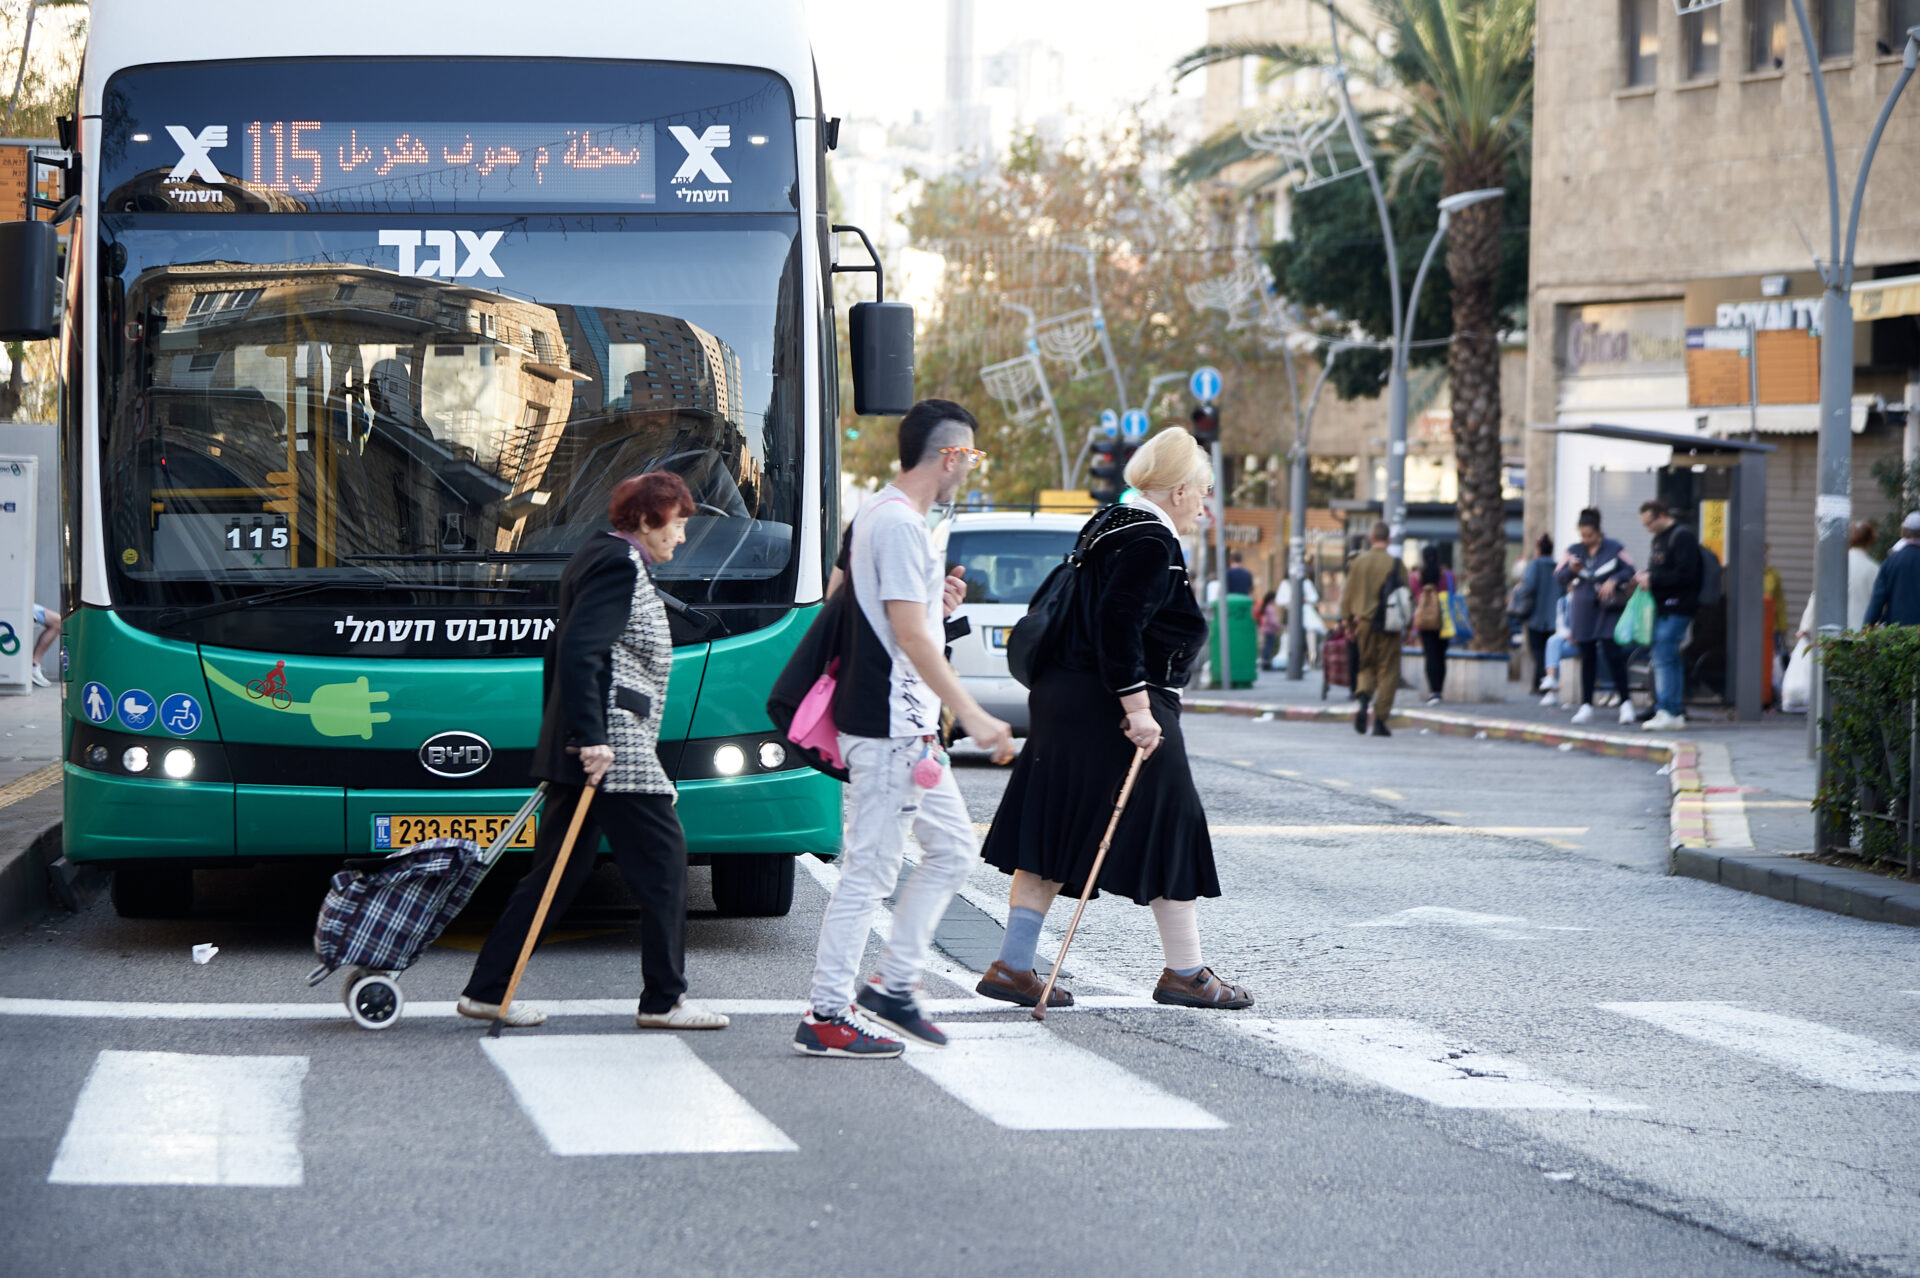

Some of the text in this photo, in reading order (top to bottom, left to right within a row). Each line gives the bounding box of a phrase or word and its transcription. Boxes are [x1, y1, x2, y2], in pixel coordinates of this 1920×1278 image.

[248, 121, 321, 191] 115
[169, 188, 223, 202] חשמלי
[676, 187, 729, 202] חשמלי
[379, 229, 505, 278] אגד
[227, 527, 288, 549] 115
[334, 615, 436, 642] חשמלי
[428, 746, 484, 765] BYD
[378, 826, 388, 839] IL
